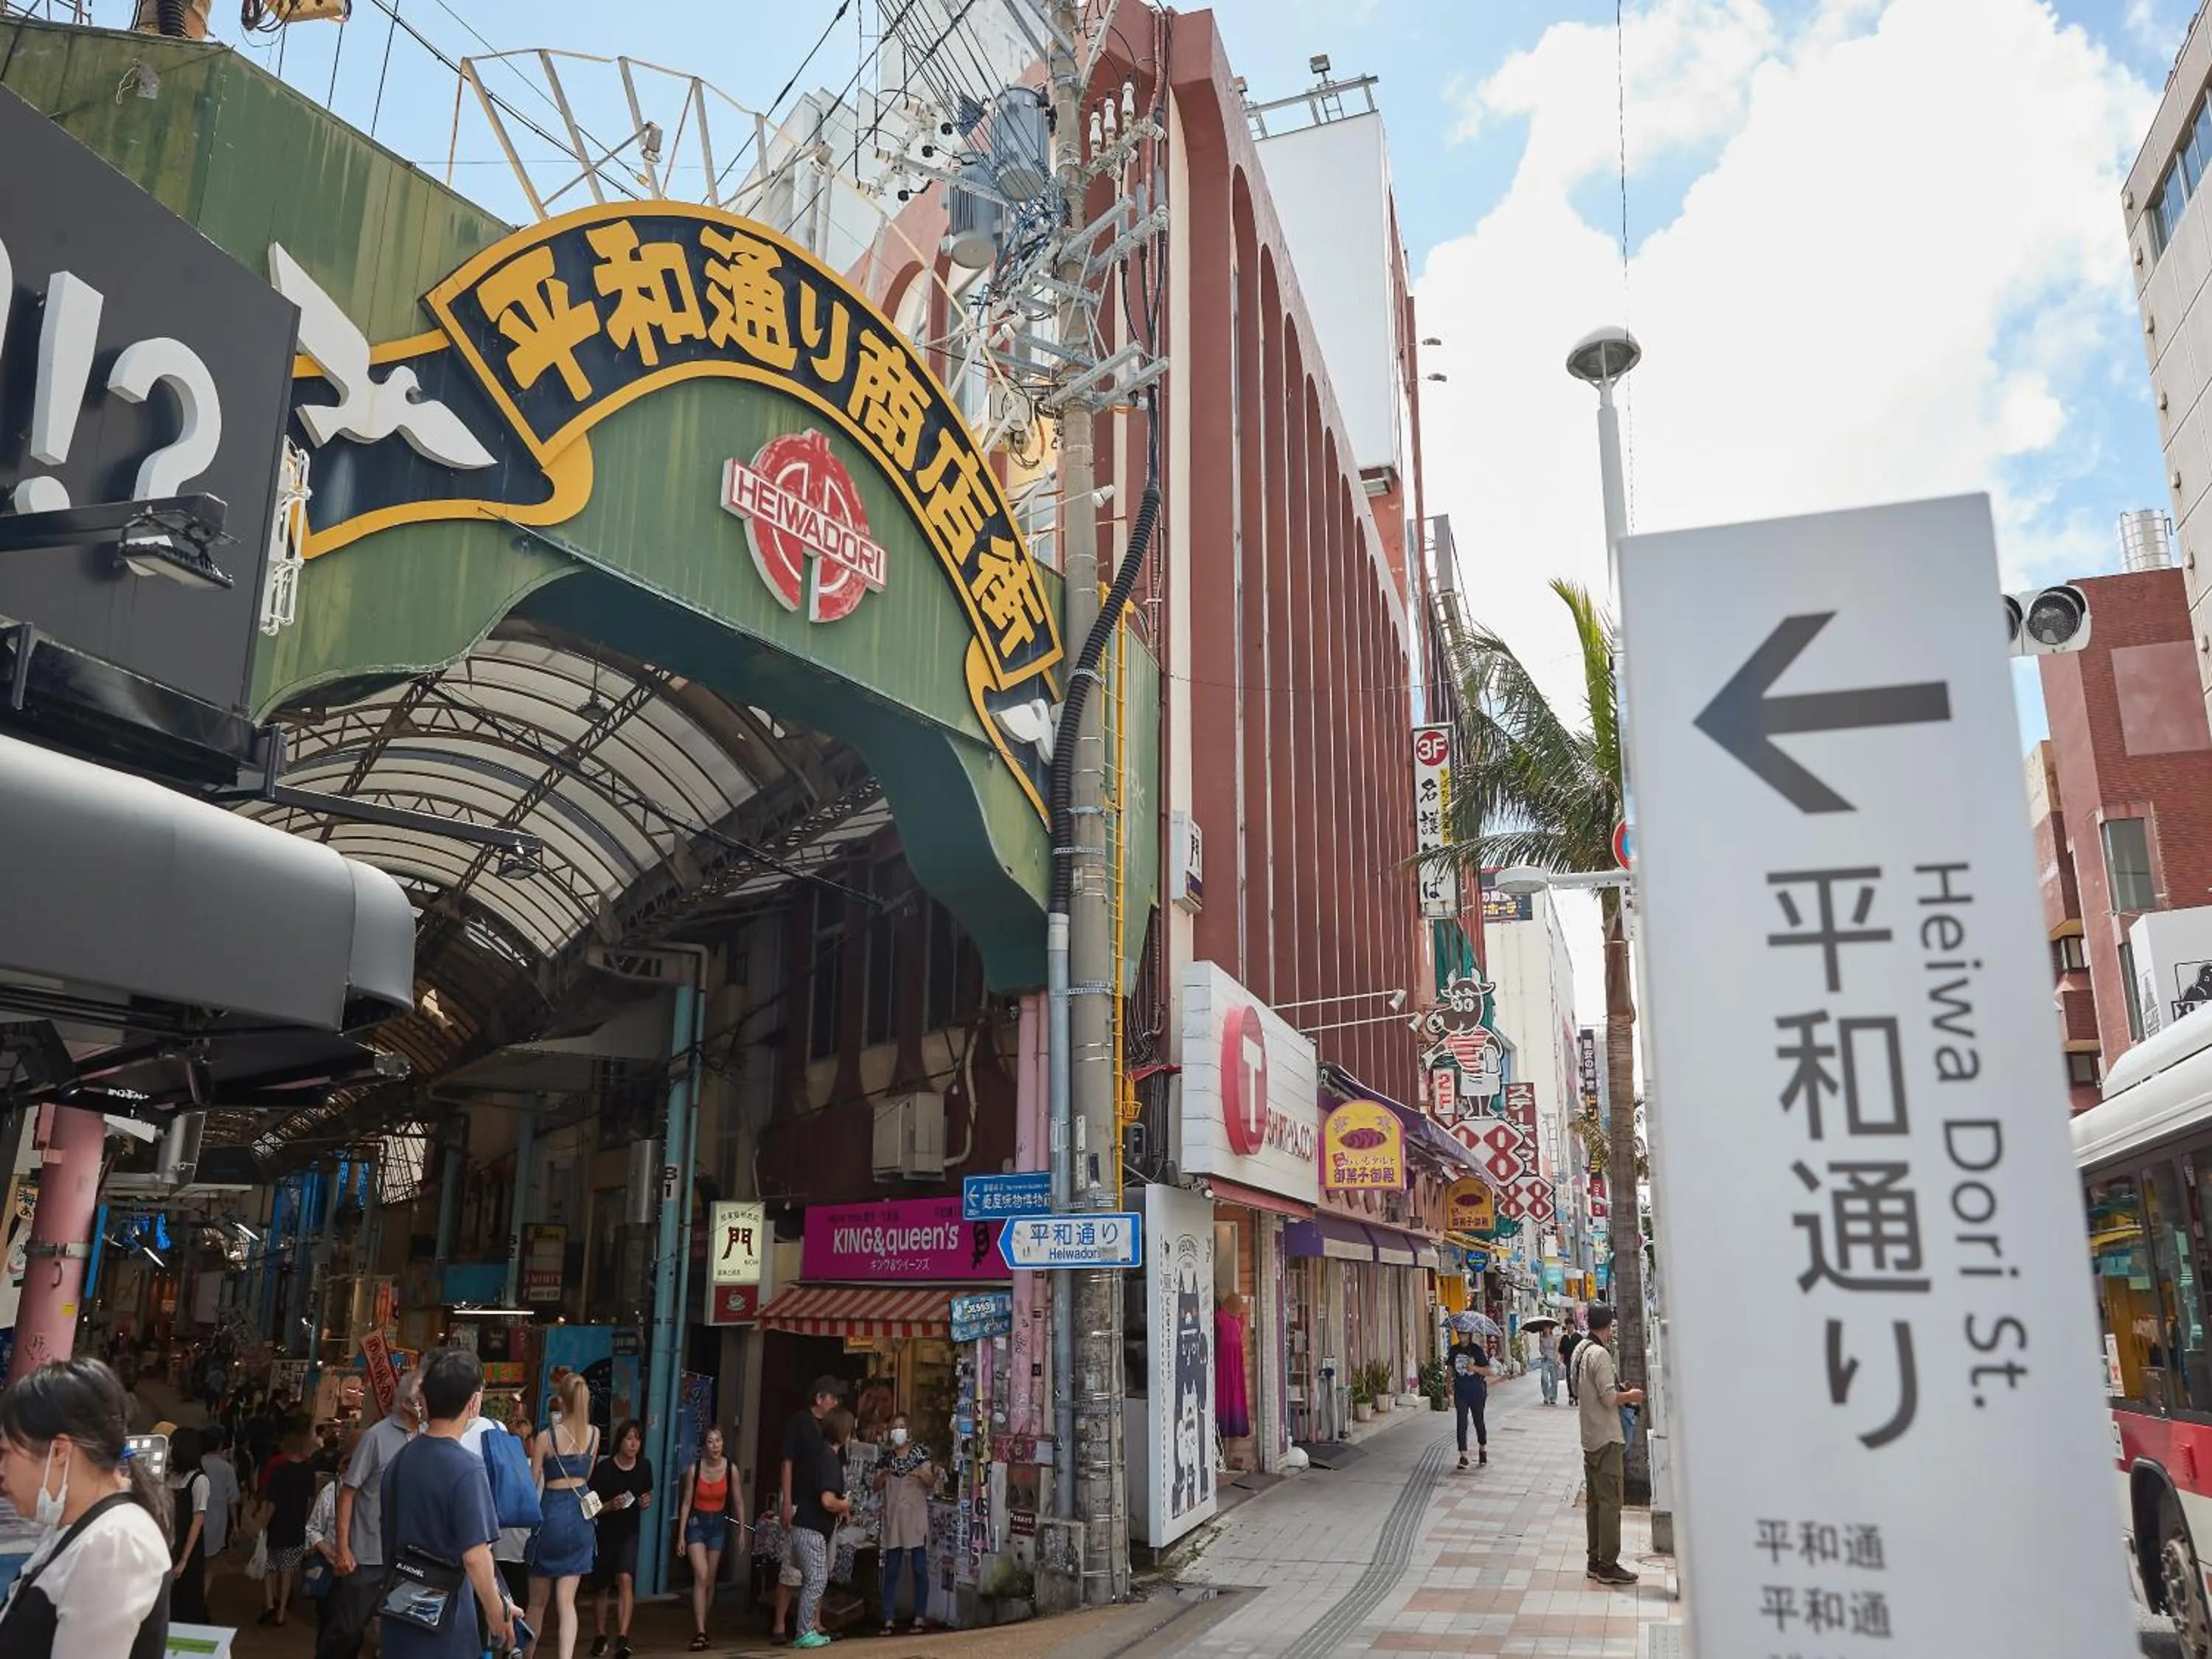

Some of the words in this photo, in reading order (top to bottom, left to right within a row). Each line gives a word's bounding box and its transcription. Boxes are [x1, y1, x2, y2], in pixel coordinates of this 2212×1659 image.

[477, 221, 1043, 658] 平和通り商店街
[737, 468, 883, 582] HEIWADORI
[1417, 738, 1447, 760] 3F
[1914, 863, 1983, 1082] Heiwa
[1767, 866, 1931, 1450] 平和通り
[1031, 1222, 1118, 1247] 平和通り
[1944, 1119, 2020, 1278] Dori
[721, 1226, 754, 1260] 門
[833, 1222, 959, 1256] KING&queen's
[1964, 1312, 2028, 1409] St.
[1755, 1519, 1885, 1571] 平和通
[1760, 1585, 1892, 1638] 平和通
